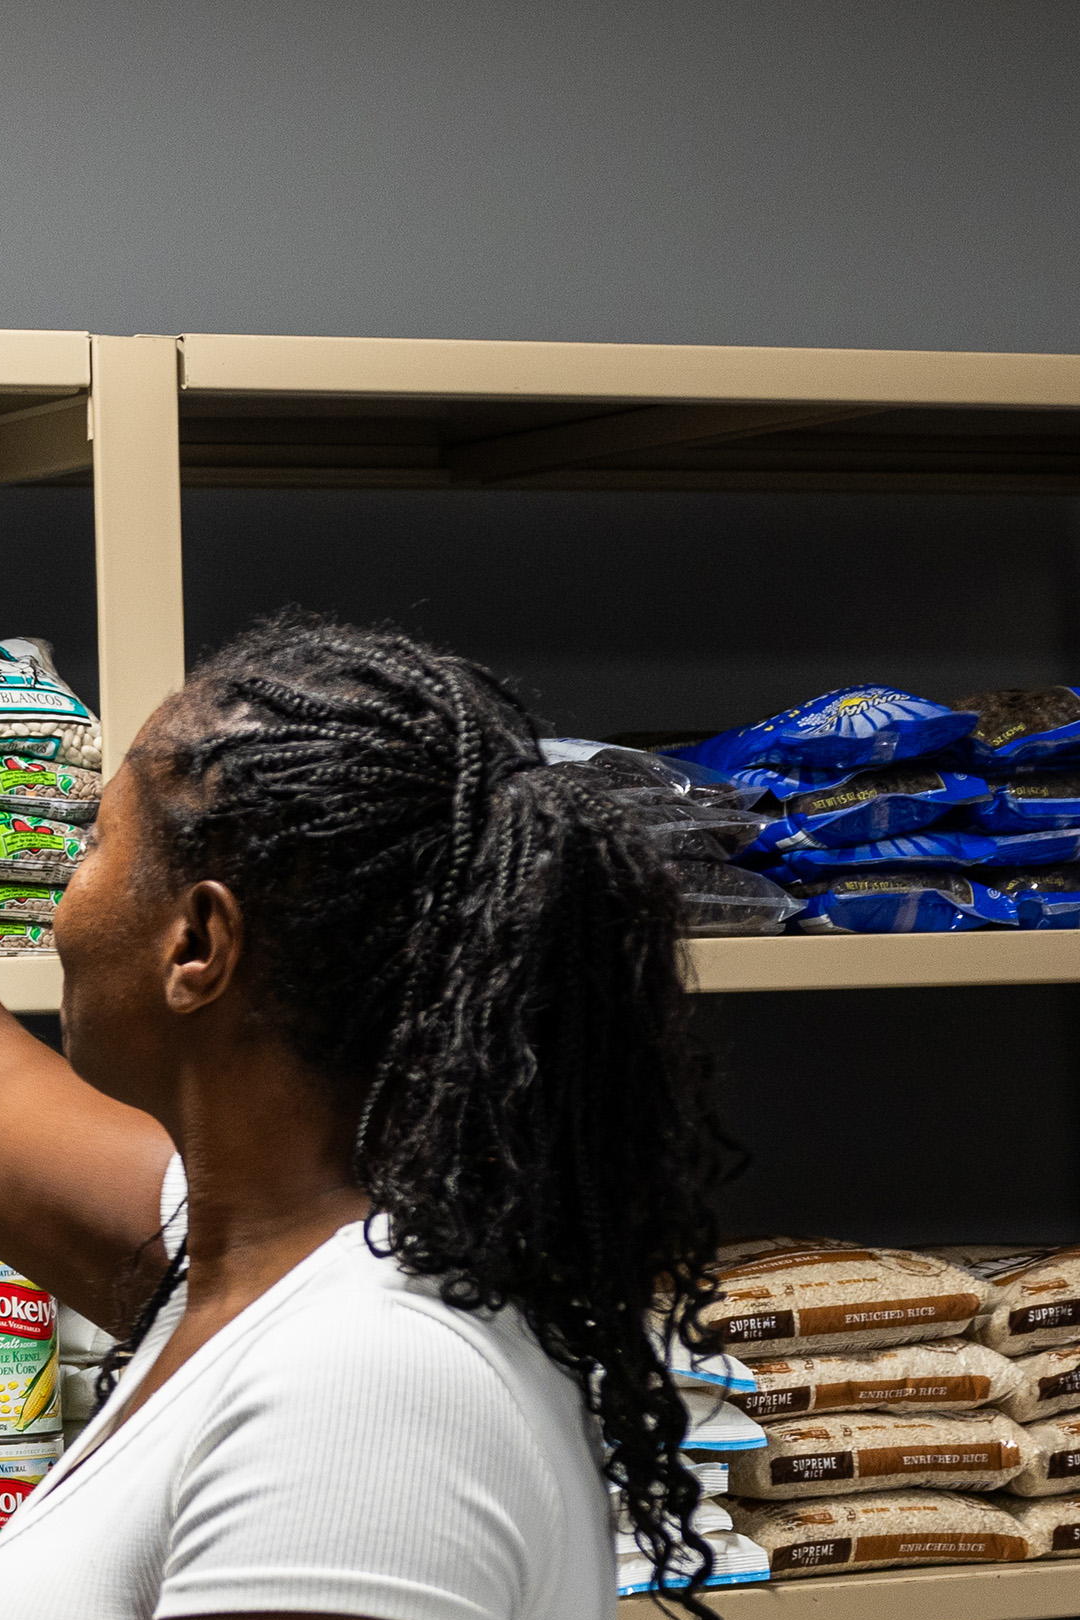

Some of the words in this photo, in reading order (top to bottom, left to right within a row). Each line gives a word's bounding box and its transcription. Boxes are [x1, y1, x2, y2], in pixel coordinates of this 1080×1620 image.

[0, 691, 63, 706] BLANCOS
[844, 1308, 905, 1325] ENRICHED
[907, 1306, 936, 1318] RICE
[729, 1315, 777, 1333] SUPREME
[743, 1328, 762, 1338] RICE
[859, 1387, 917, 1400] ENRICHED
[920, 1385, 947, 1397] RICE
[746, 1393, 793, 1409] SUPREME
[793, 1456, 837, 1471] SUPREME
[903, 1454, 960, 1466] ENRICHED
[963, 1452, 989, 1465] RICE
[792, 1543, 834, 1559] SUPREME
[898, 1541, 955, 1553] ENRICHED
[957, 1541, 985, 1553] RICE
